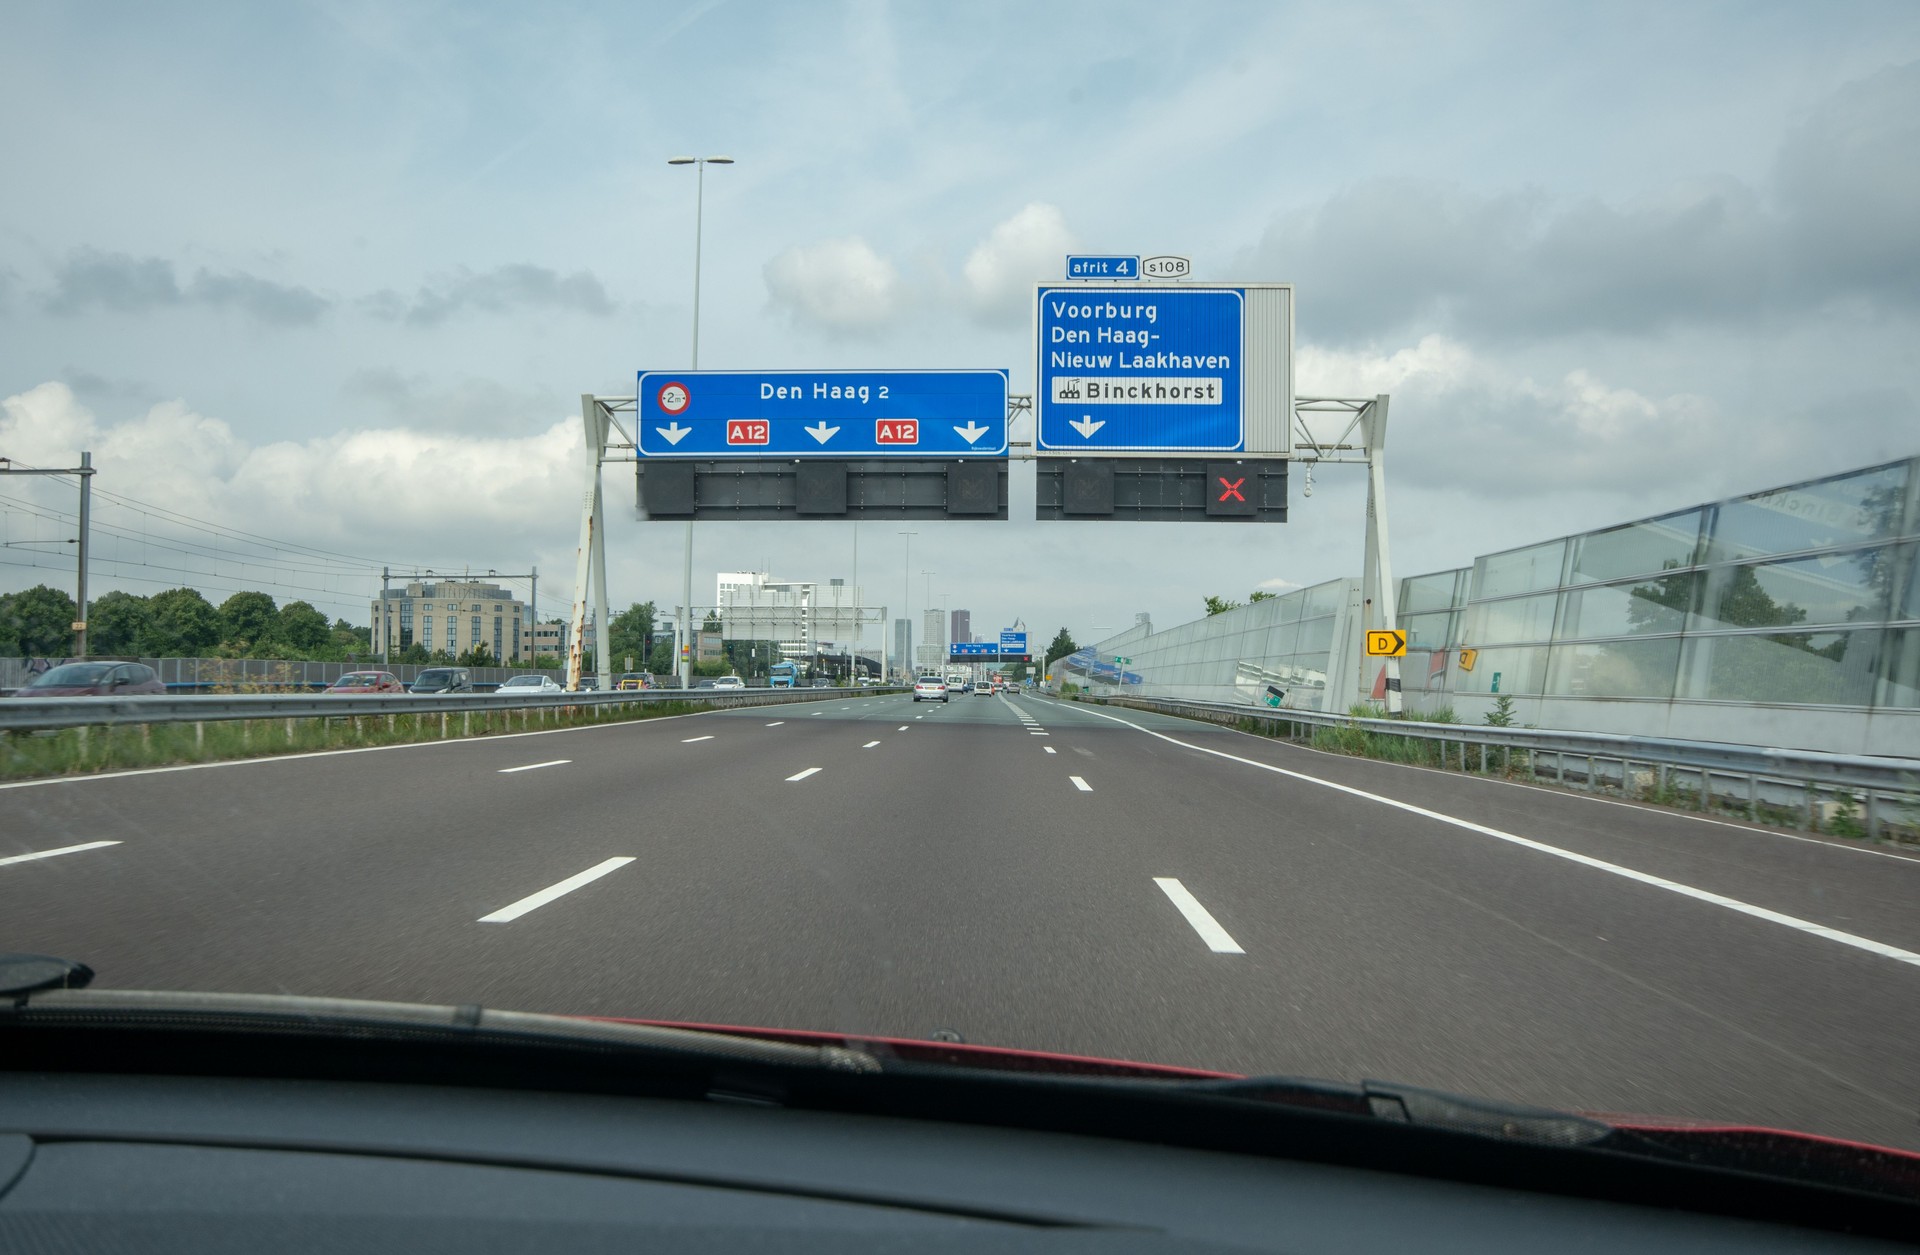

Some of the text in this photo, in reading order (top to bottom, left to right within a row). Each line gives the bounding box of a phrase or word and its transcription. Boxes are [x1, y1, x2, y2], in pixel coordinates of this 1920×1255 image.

[1074, 261, 1128, 274] afrit 4
[1150, 262, 1184, 272] s108
[1052, 302, 1157, 323] Voorburg
[1052, 327, 1159, 348] Den Haag-
[1051, 352, 1229, 369] Nieuw Laakhaven
[761, 383, 889, 403] Den Haag 2
[1087, 383, 1215, 398] Binckhorst
[731, 426, 765, 439] A12
[880, 426, 914, 439] A12
[1379, 638, 1388, 650] D
